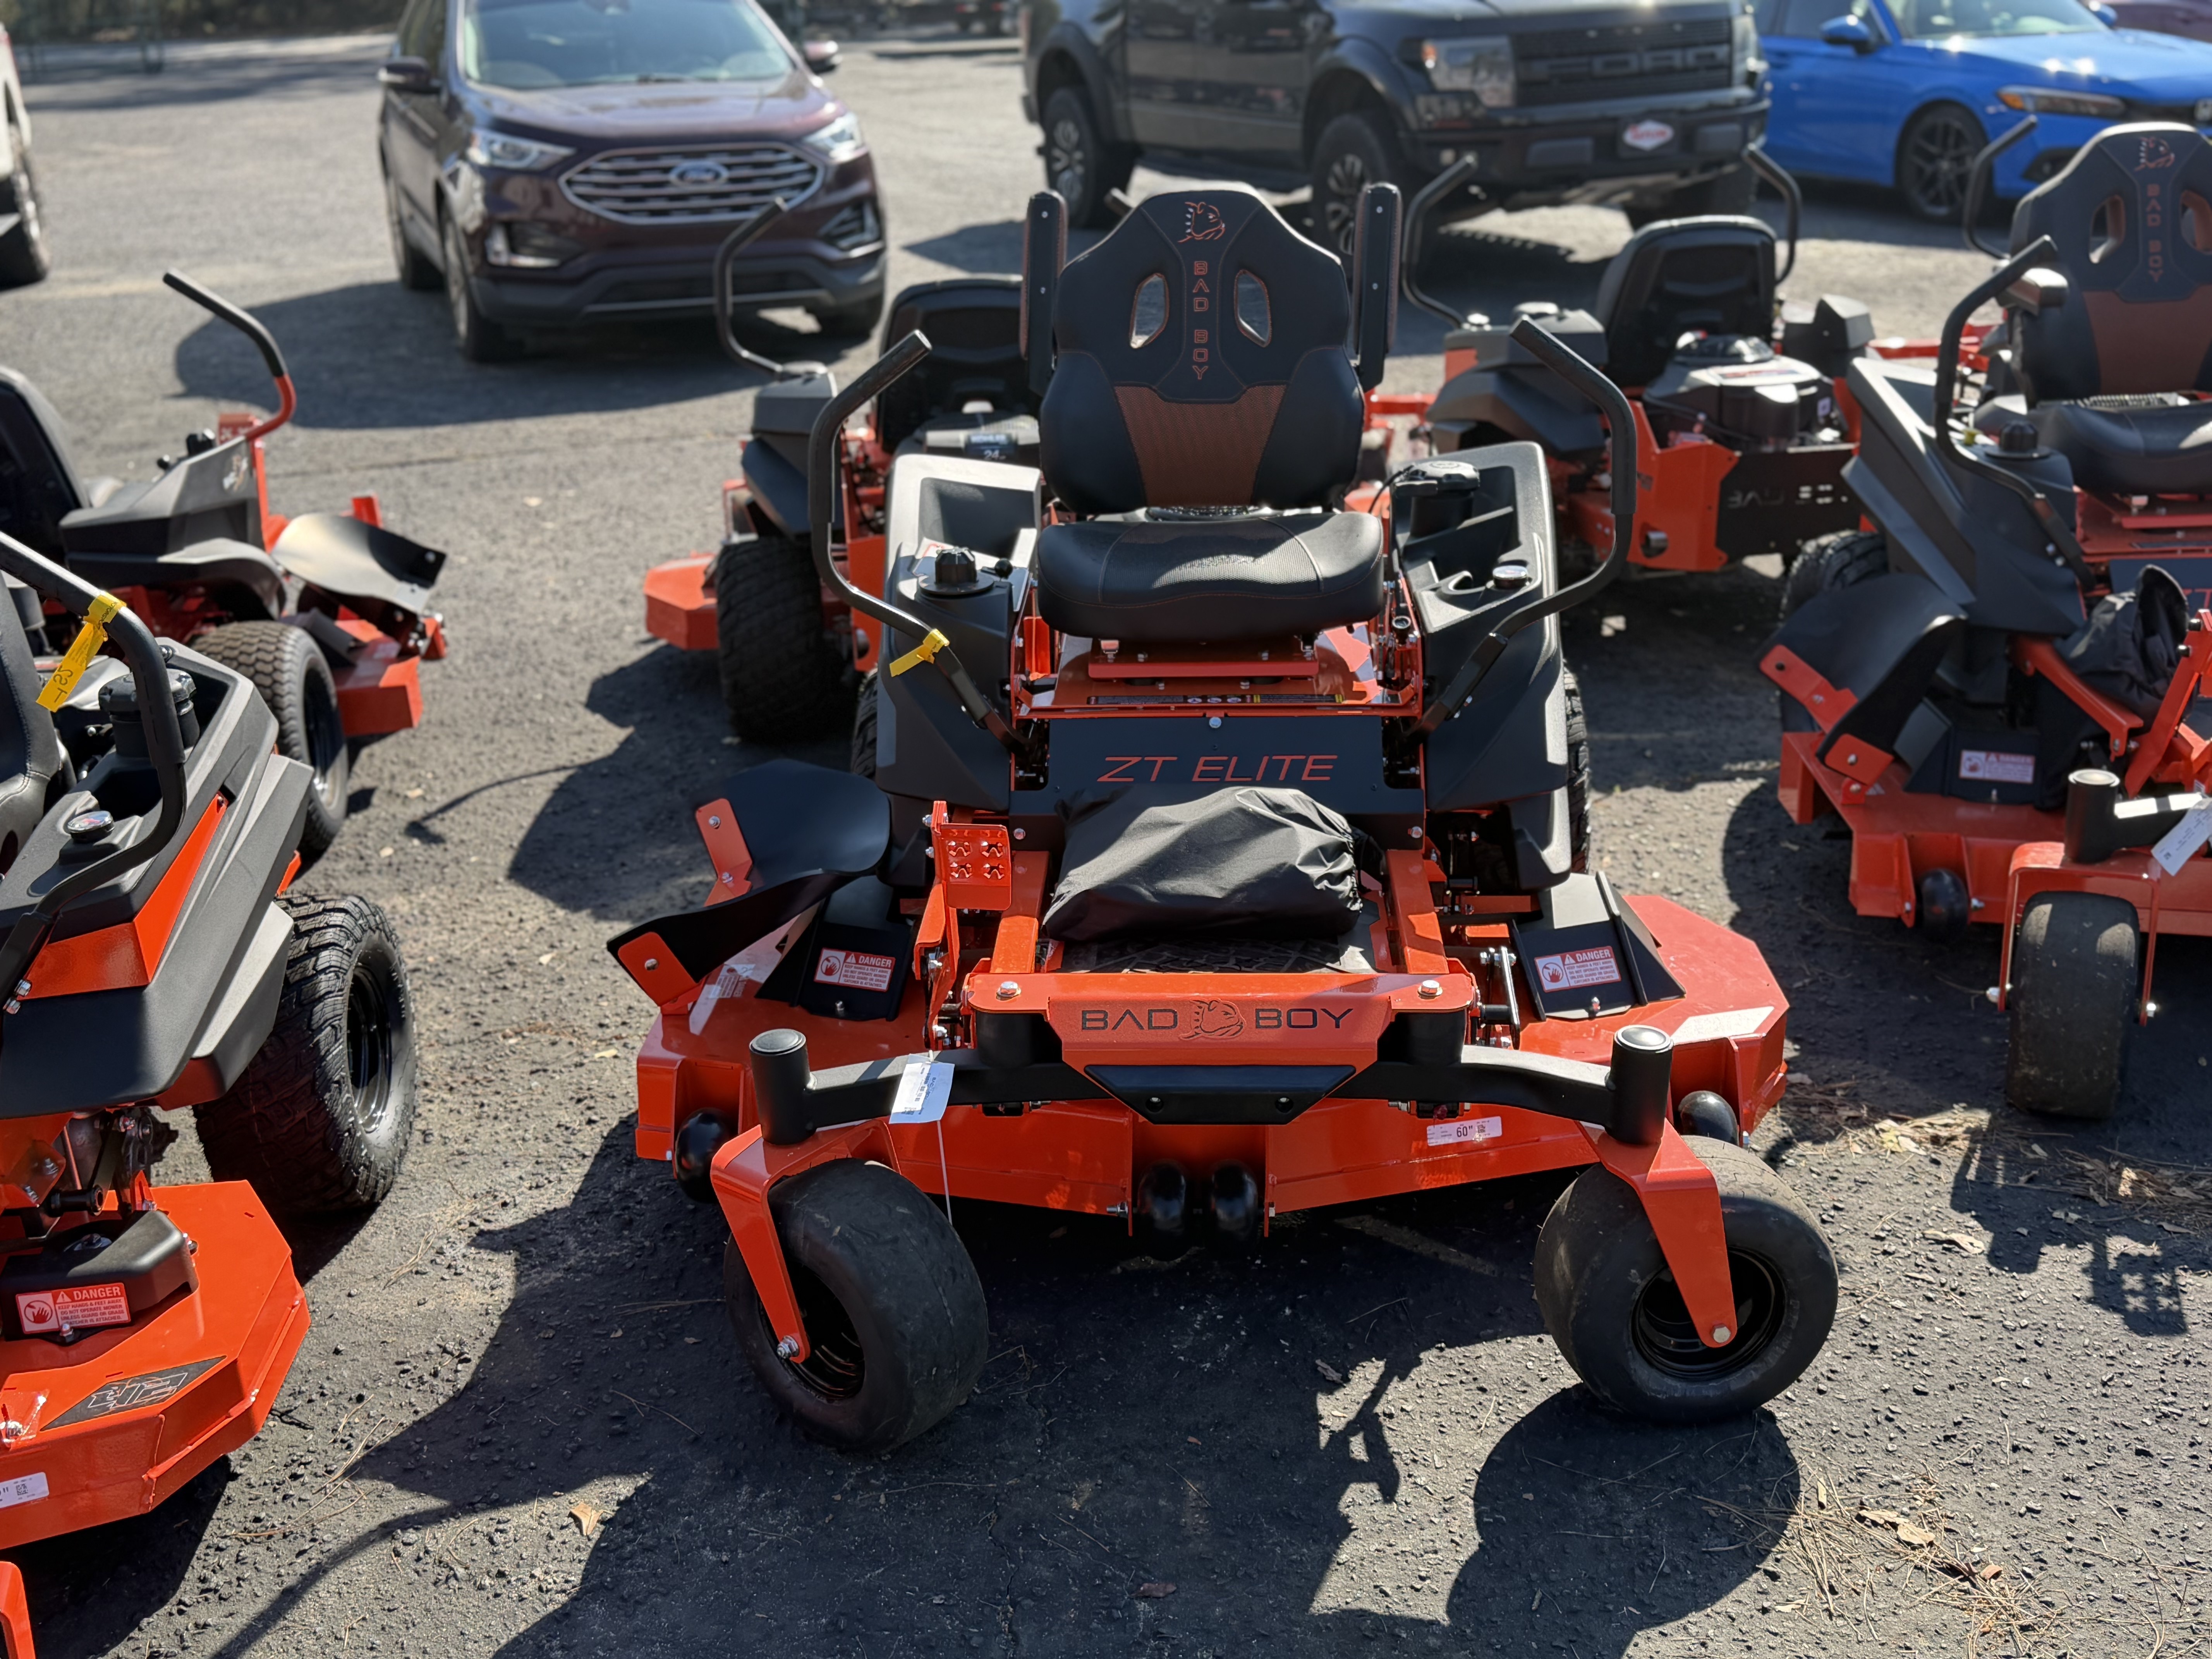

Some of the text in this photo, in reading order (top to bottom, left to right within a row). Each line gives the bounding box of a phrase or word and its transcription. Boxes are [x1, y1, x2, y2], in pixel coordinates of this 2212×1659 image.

[1192, 261, 1209, 380] BAD BOY
[984, 449, 1000, 460] 24
[1097, 755, 1338, 781] ZT ELITE
[859, 955, 892, 968] DANGER
[1575, 949, 1611, 962] DANGER
[1081, 1008, 1354, 1030] BAD BOY
[1456, 1125, 1473, 1138] 60"
[73, 1286, 121, 1300] DANGER
